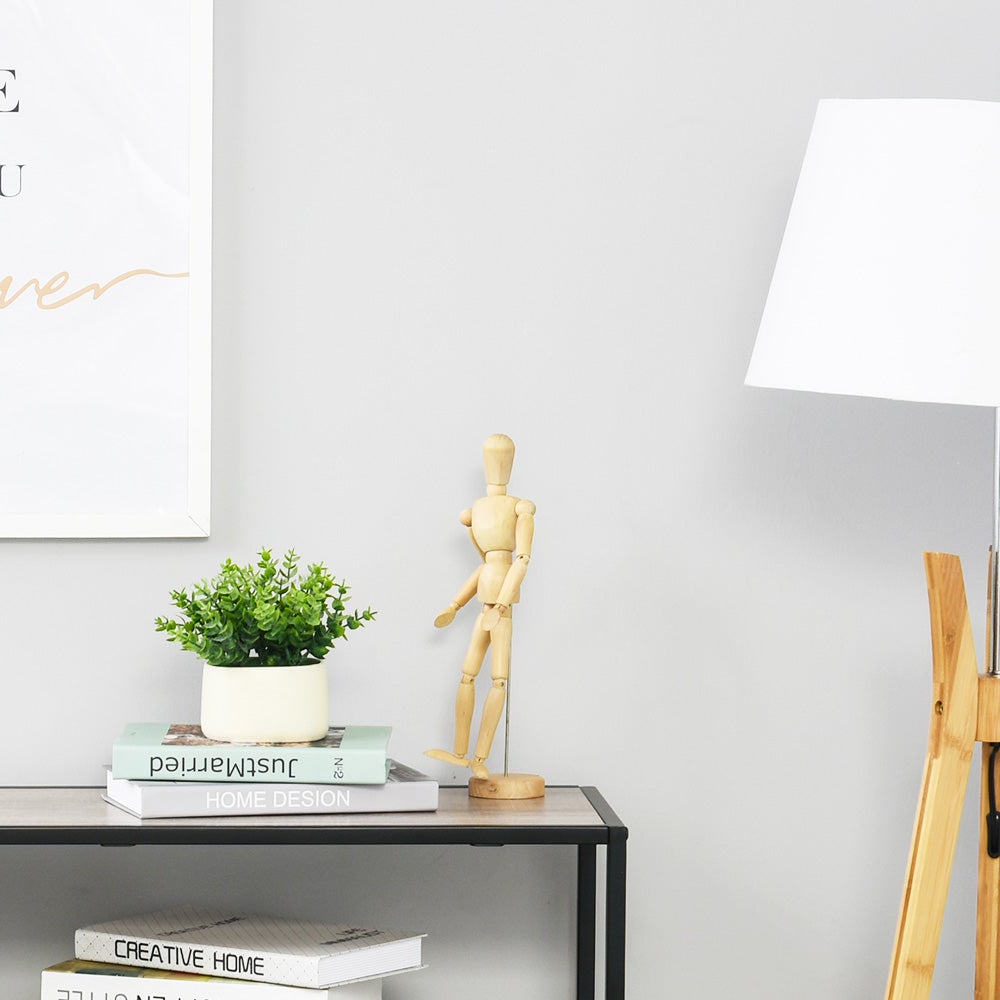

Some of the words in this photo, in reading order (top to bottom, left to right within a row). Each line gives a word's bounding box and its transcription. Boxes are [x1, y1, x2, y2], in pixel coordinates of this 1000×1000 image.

[149, 756, 299, 779] JustMarried
[206, 791, 267, 810] HOME
[114, 939, 204, 968] CREATIVE
[213, 951, 265, 976] HOME
